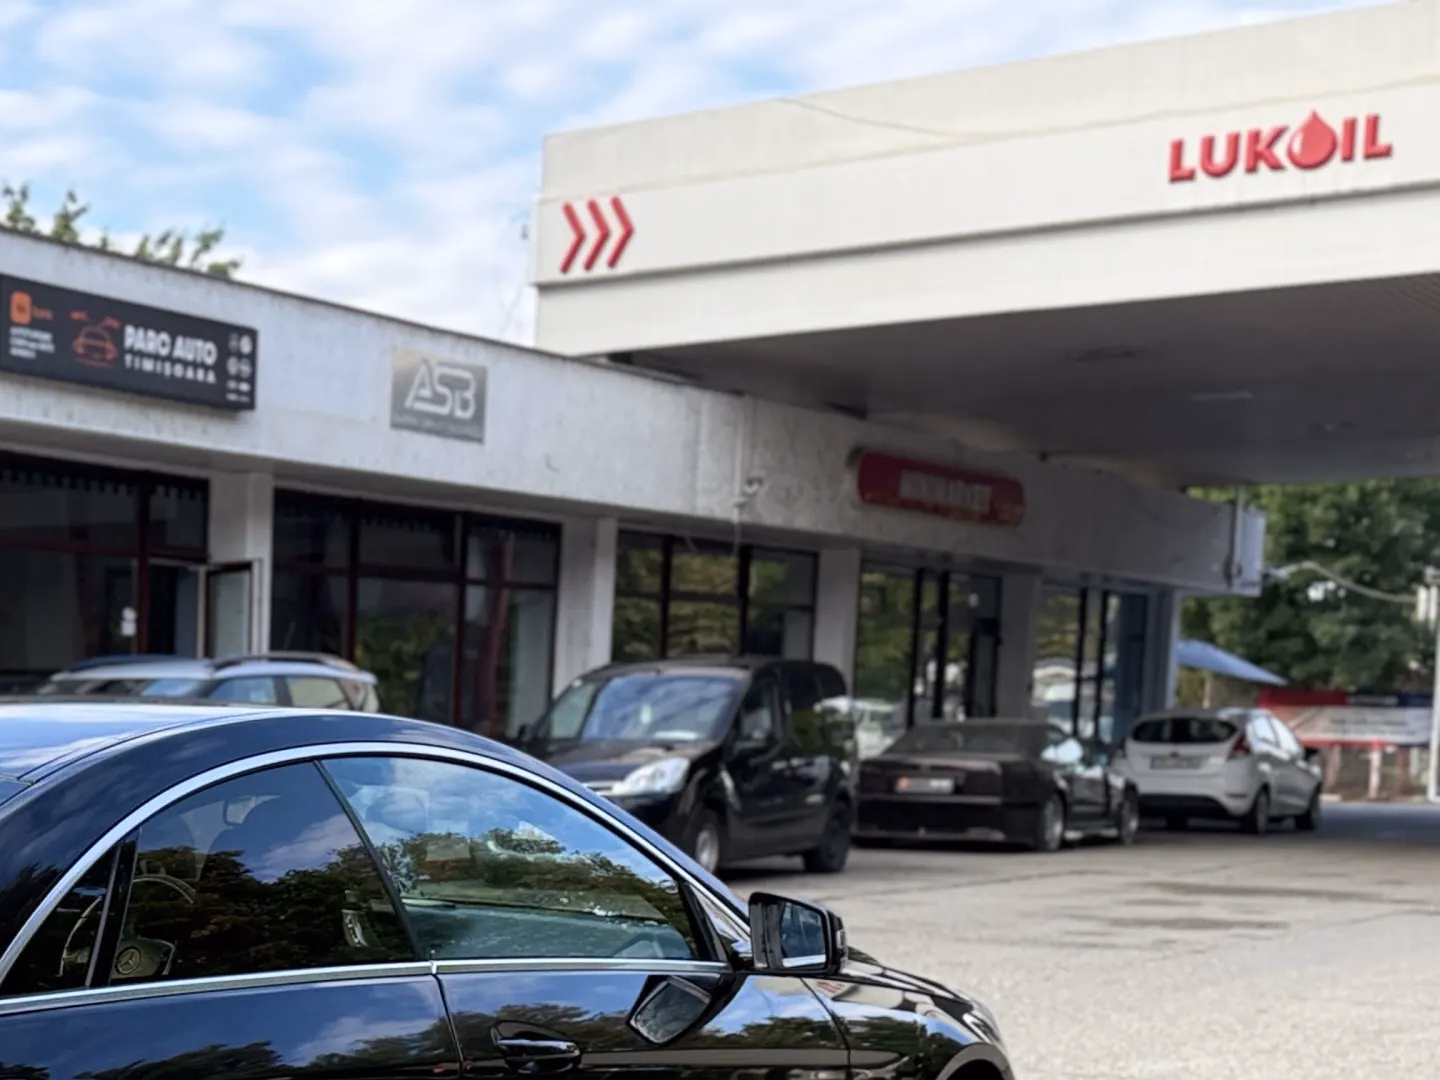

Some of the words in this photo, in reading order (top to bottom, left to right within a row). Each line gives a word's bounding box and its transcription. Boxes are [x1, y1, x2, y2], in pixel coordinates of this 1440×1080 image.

[1168, 109, 1393, 184] LUKOIL
[124, 324, 171, 357] PARC
[172, 335, 218, 366] AUTO
[404, 362, 476, 418] ASB
